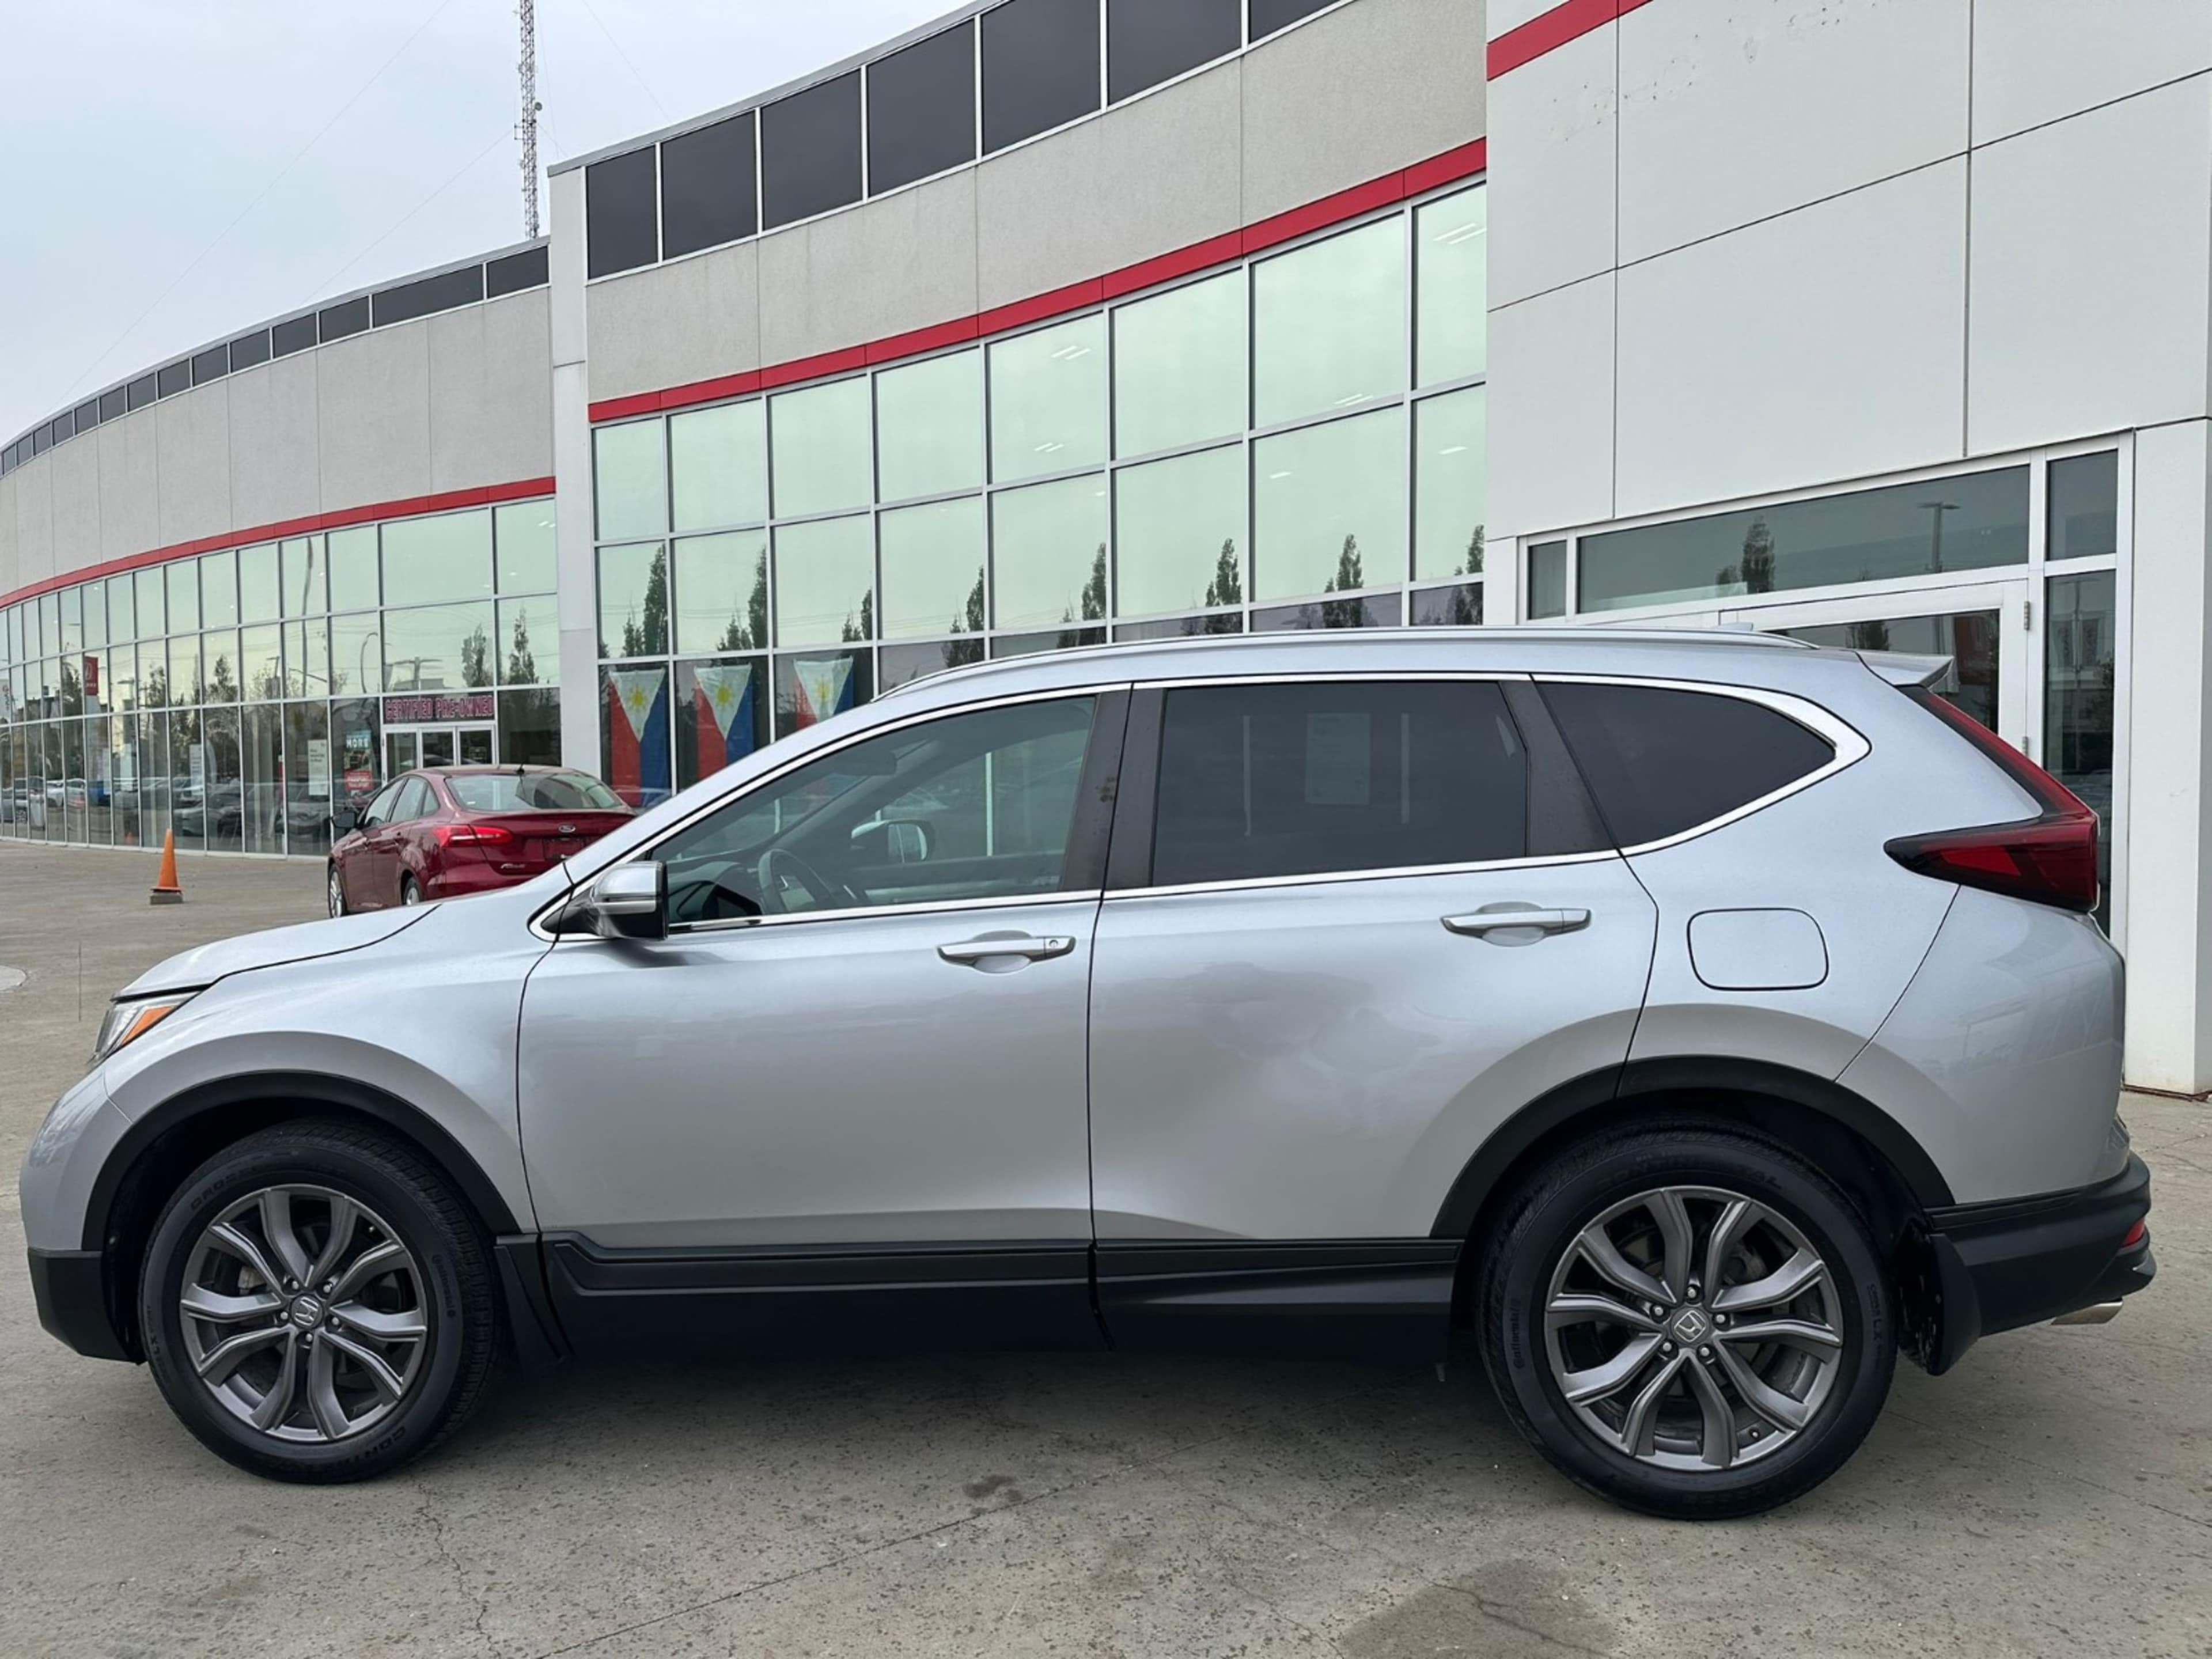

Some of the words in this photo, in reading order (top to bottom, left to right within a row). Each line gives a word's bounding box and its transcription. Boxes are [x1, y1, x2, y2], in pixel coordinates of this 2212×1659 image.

[385, 698, 433, 720] CERTIFIED
[435, 695, 494, 718] PRE-OWNED
[346, 737, 369, 748] MORE
